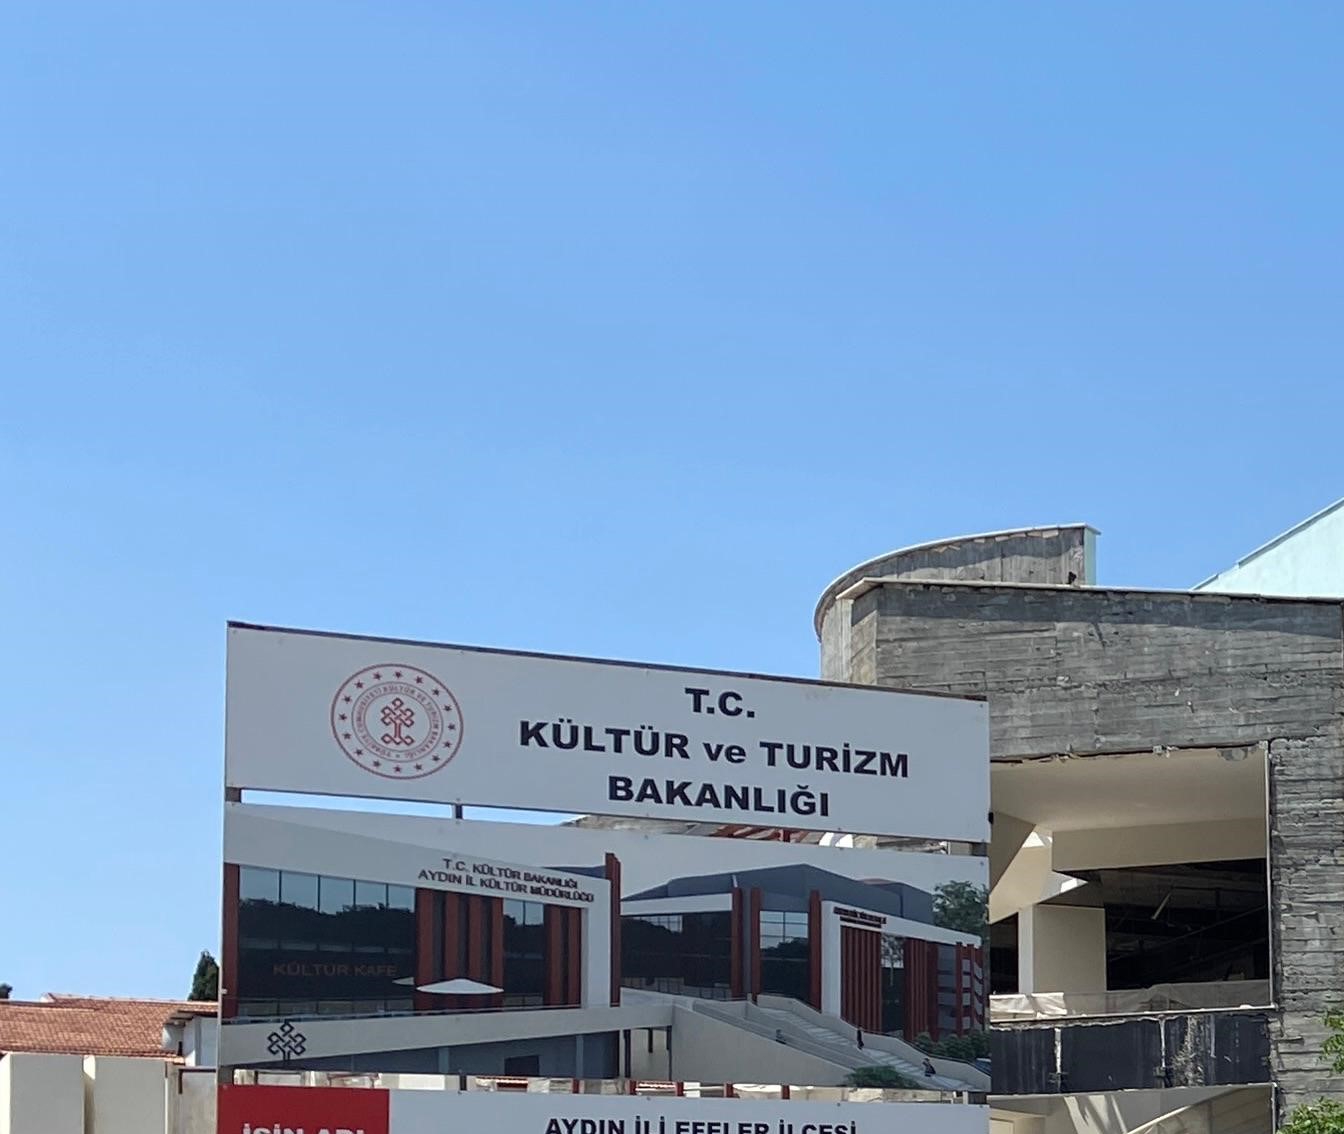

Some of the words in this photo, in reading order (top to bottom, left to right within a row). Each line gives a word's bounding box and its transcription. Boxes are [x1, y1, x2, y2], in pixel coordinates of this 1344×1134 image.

[684, 687, 755, 719] T.C.
[520, 718, 690, 760] KÜLTÜR
[702, 742, 747, 764] ve
[759, 741, 908, 778] TURİZM
[607, 775, 830, 817] BAKANLIĞI
[418, 869, 462, 884] AYDIN
